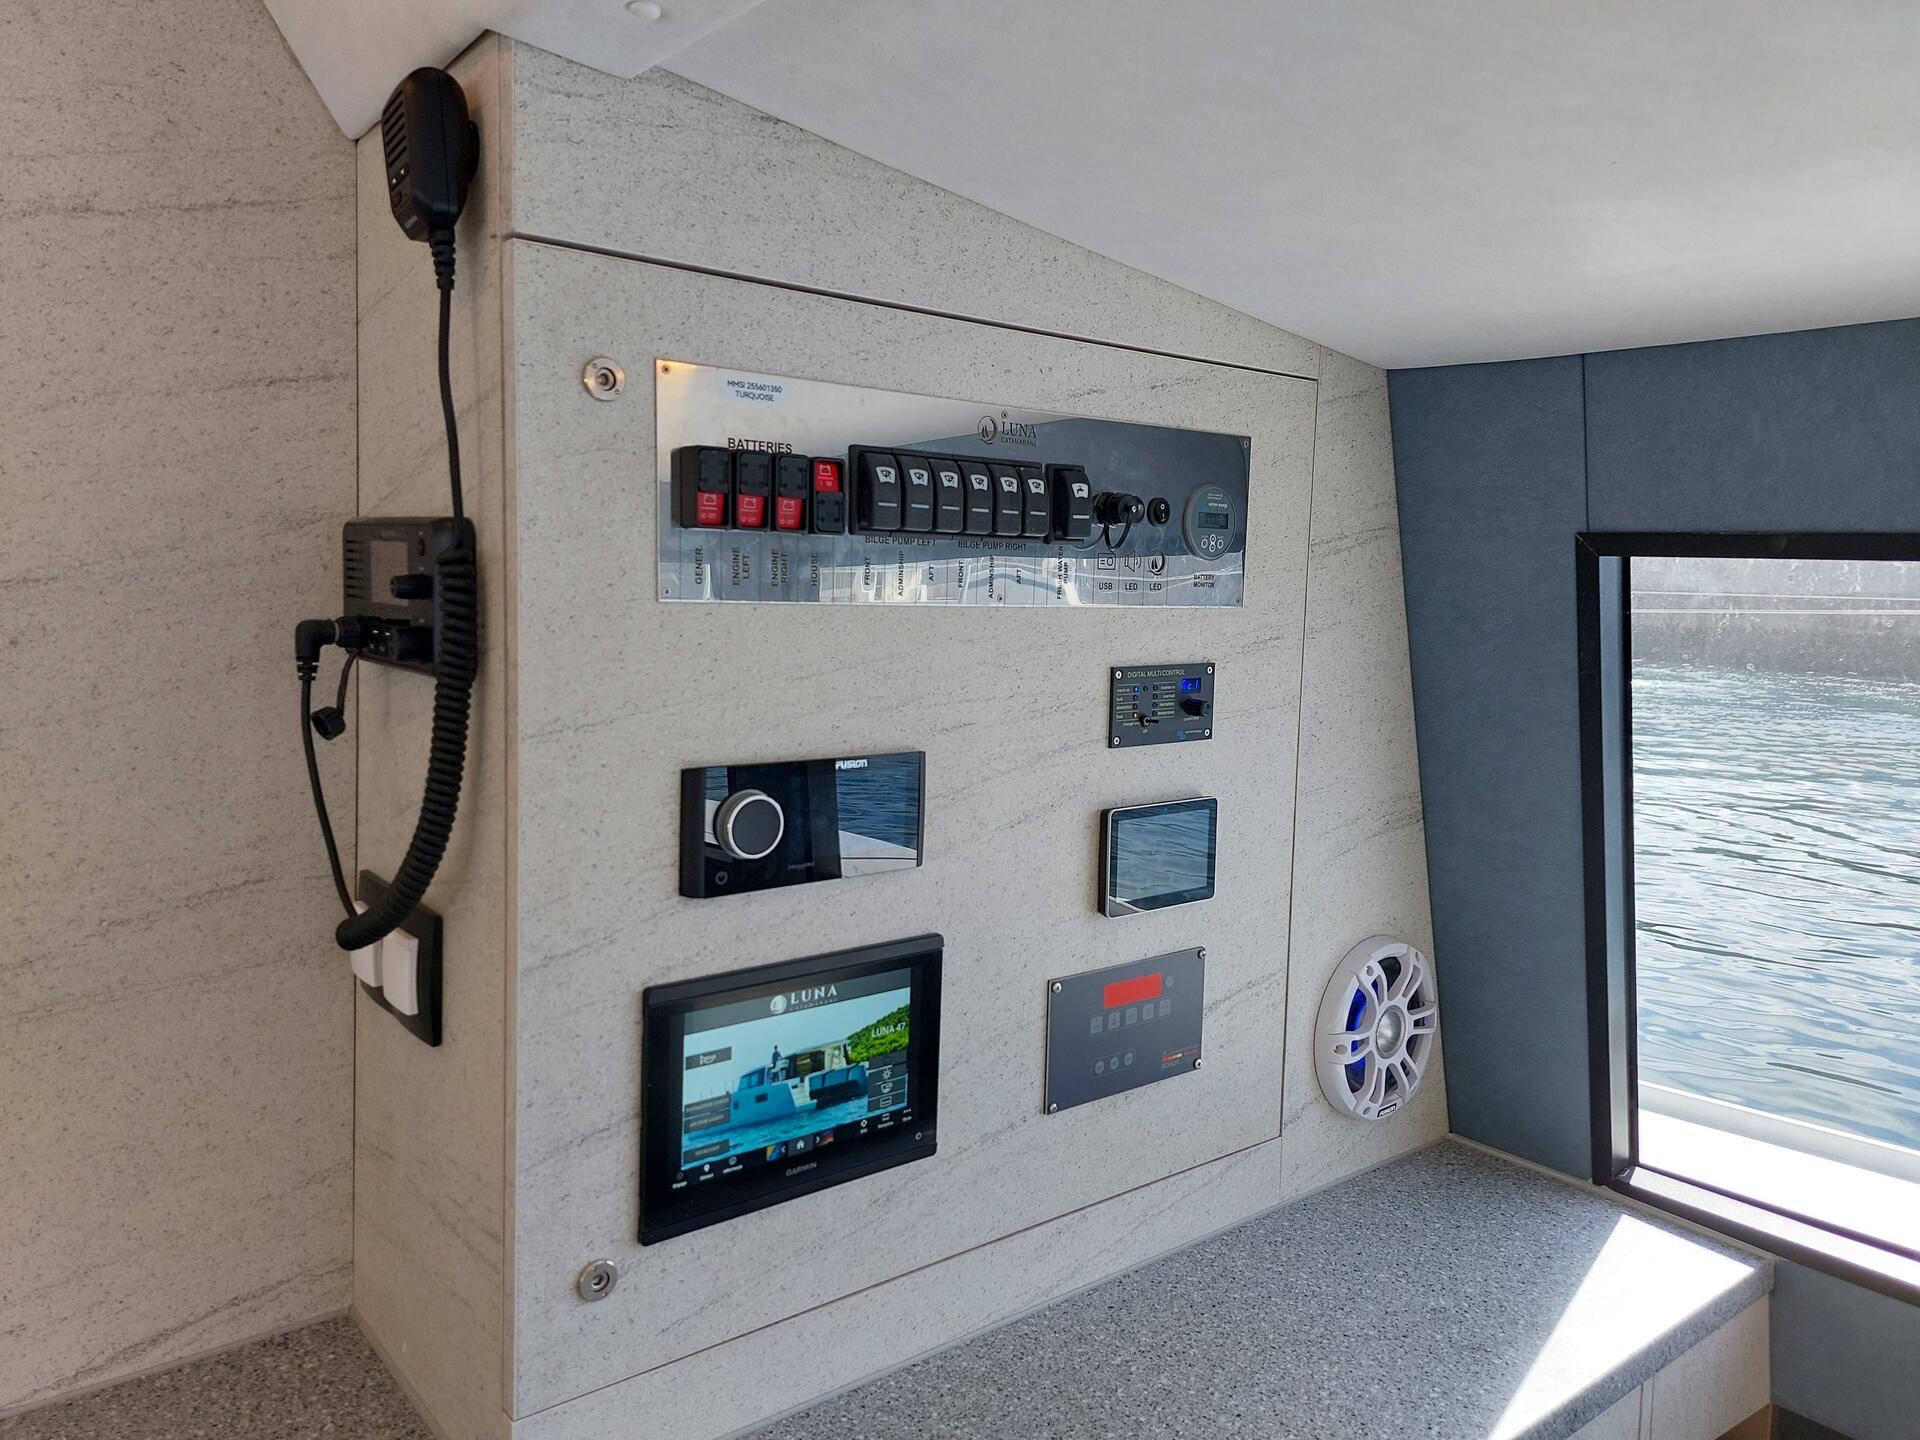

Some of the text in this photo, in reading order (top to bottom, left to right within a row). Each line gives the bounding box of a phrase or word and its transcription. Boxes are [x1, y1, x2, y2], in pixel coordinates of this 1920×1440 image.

[727, 380, 783, 394] MMSI 255601350
[735, 390, 775, 402] TURQUOISE
[1001, 421, 1038, 439] LUNA
[728, 437, 793, 455] BATTERIES
[865, 536, 936, 547] BILGE PUMP LEFT
[958, 540, 1027, 551] BILGE PUMP RIGHT
[732, 546, 740, 586] ENGINE
[742, 553, 751, 580] LEFT
[771, 547, 779, 587] ENGINE
[810, 551, 818, 587] HOUSE
[1193, 573, 1216, 581] BATTERY
[1098, 582, 1113, 590] USB
[1124, 582, 1138, 591] LED
[1149, 583, 1162, 591] LED
[1127, 671, 1147, 679] DIGITAL
[1162, 669, 1186, 677] CONTROL
[835, 758, 868, 770] FUSION
[790, 984, 839, 1006] LUNA
[871, 1021, 906, 1038] LUNA 47
[785, 1161, 818, 1177] GARMIN
